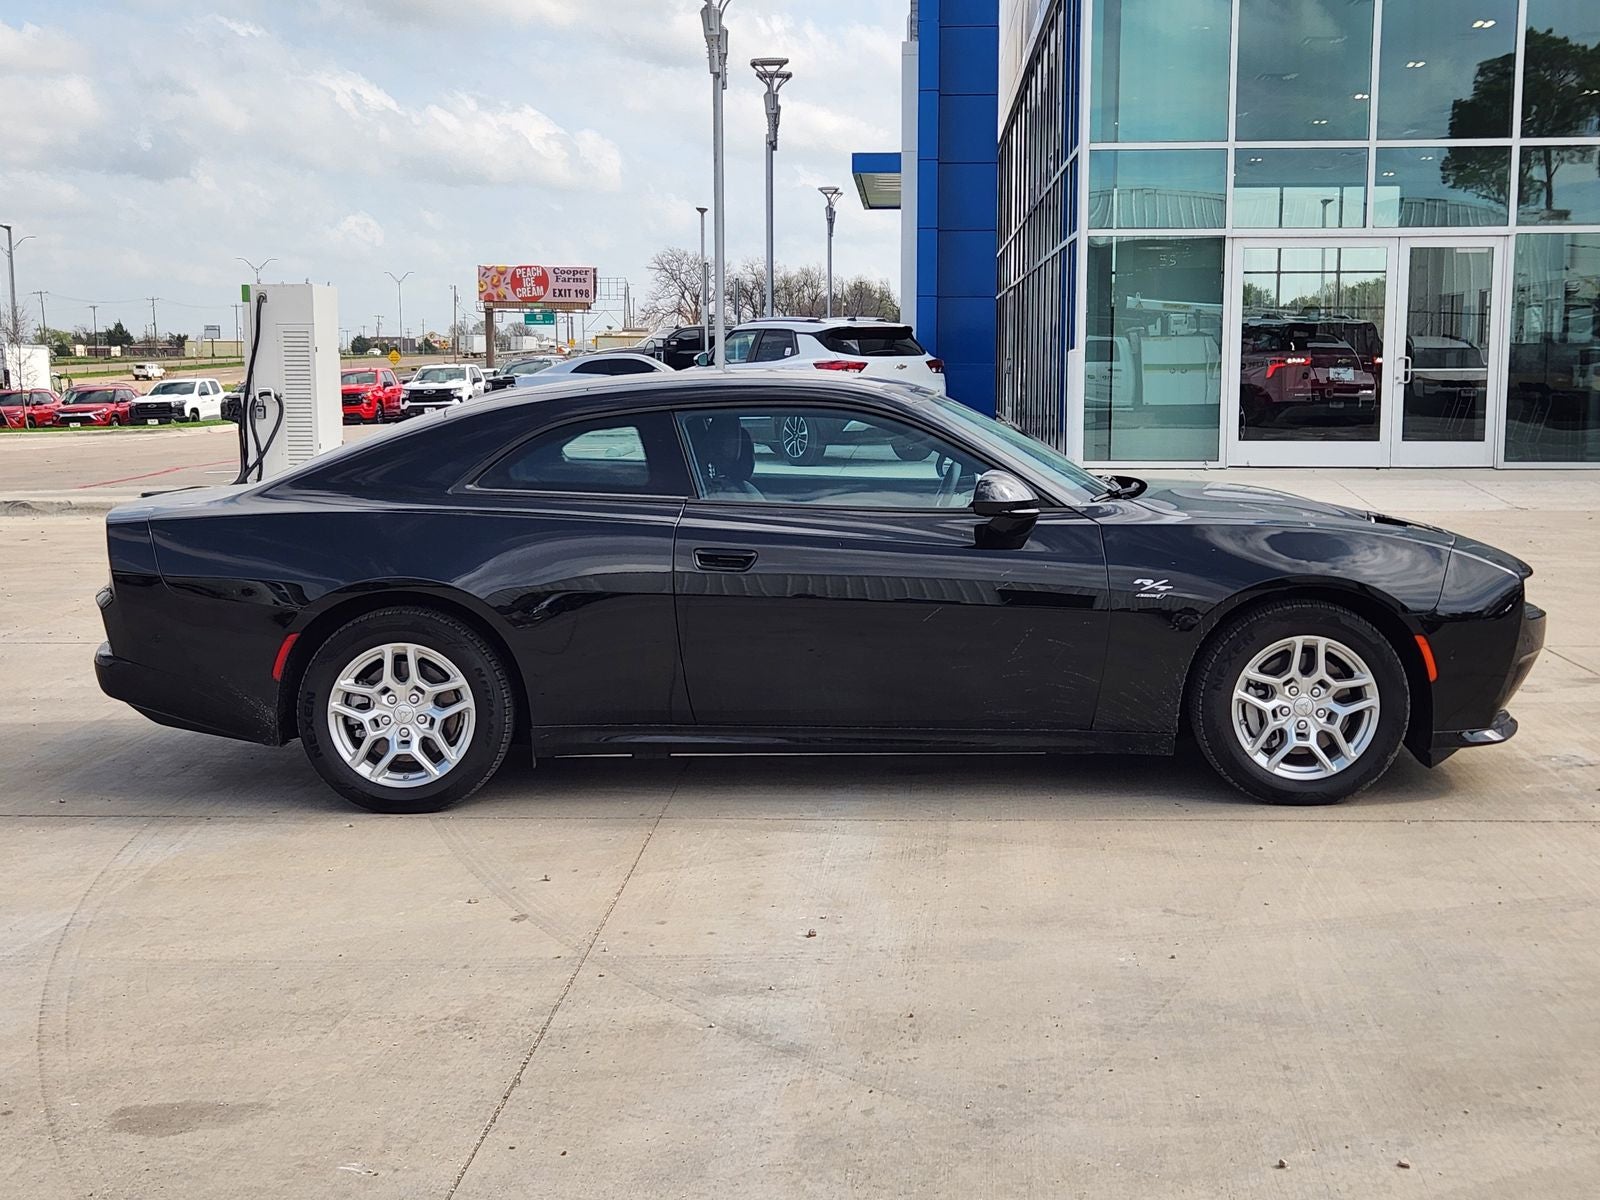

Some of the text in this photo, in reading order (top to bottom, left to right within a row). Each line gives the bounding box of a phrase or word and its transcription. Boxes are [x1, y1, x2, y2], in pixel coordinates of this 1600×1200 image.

[516, 267, 542, 278] PEACH
[553, 267, 590, 277] Cooper
[523, 278, 535, 287] ICE
[555, 275, 587, 283] Farms
[516, 288, 544, 298] CREAM
[553, 288, 590, 298] EXIT 198
[304, 691, 323, 759] NEXEN
